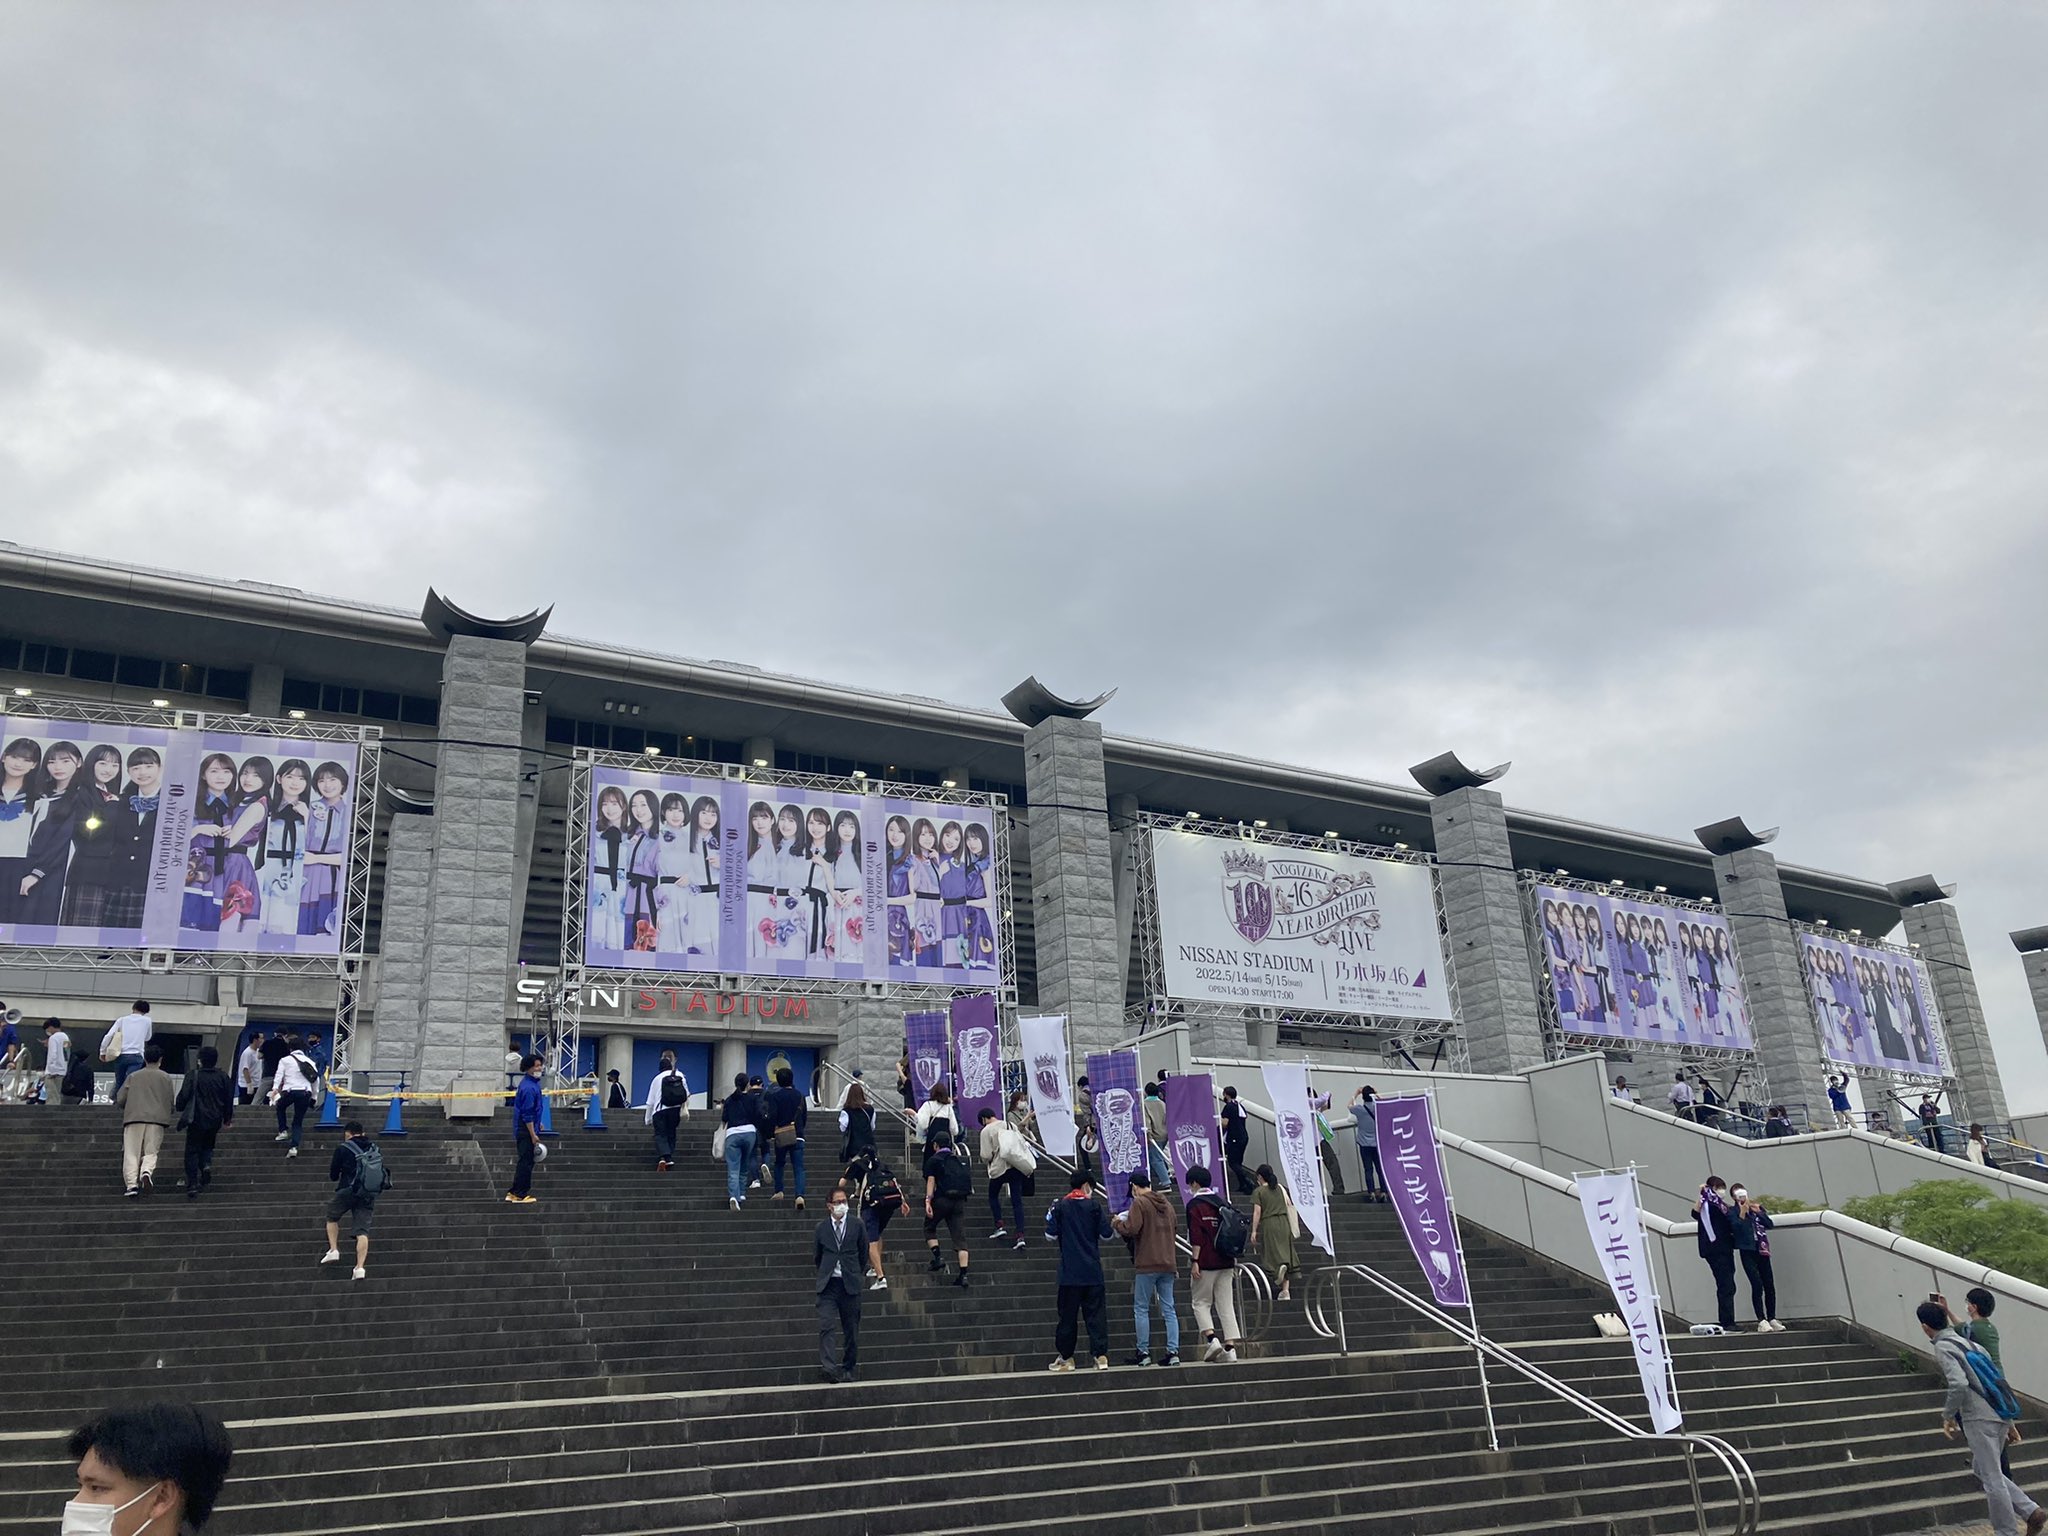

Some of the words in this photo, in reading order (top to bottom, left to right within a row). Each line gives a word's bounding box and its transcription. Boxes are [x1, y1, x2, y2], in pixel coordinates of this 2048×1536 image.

[1272, 864, 1329, 881] NOGIZAKA
[1287, 881, 1313, 908] 46
[1276, 915, 1314, 936] YEAR
[1315, 890, 1377, 928] BIRTHDAY
[1338, 929, 1376, 955] LIVE
[1178, 944, 1238, 966] NISSAN
[1243, 951, 1315, 974] STADIUM
[1335, 961, 1409, 986] 乃木坂46
[639, 988, 809, 1018] STADIUM
